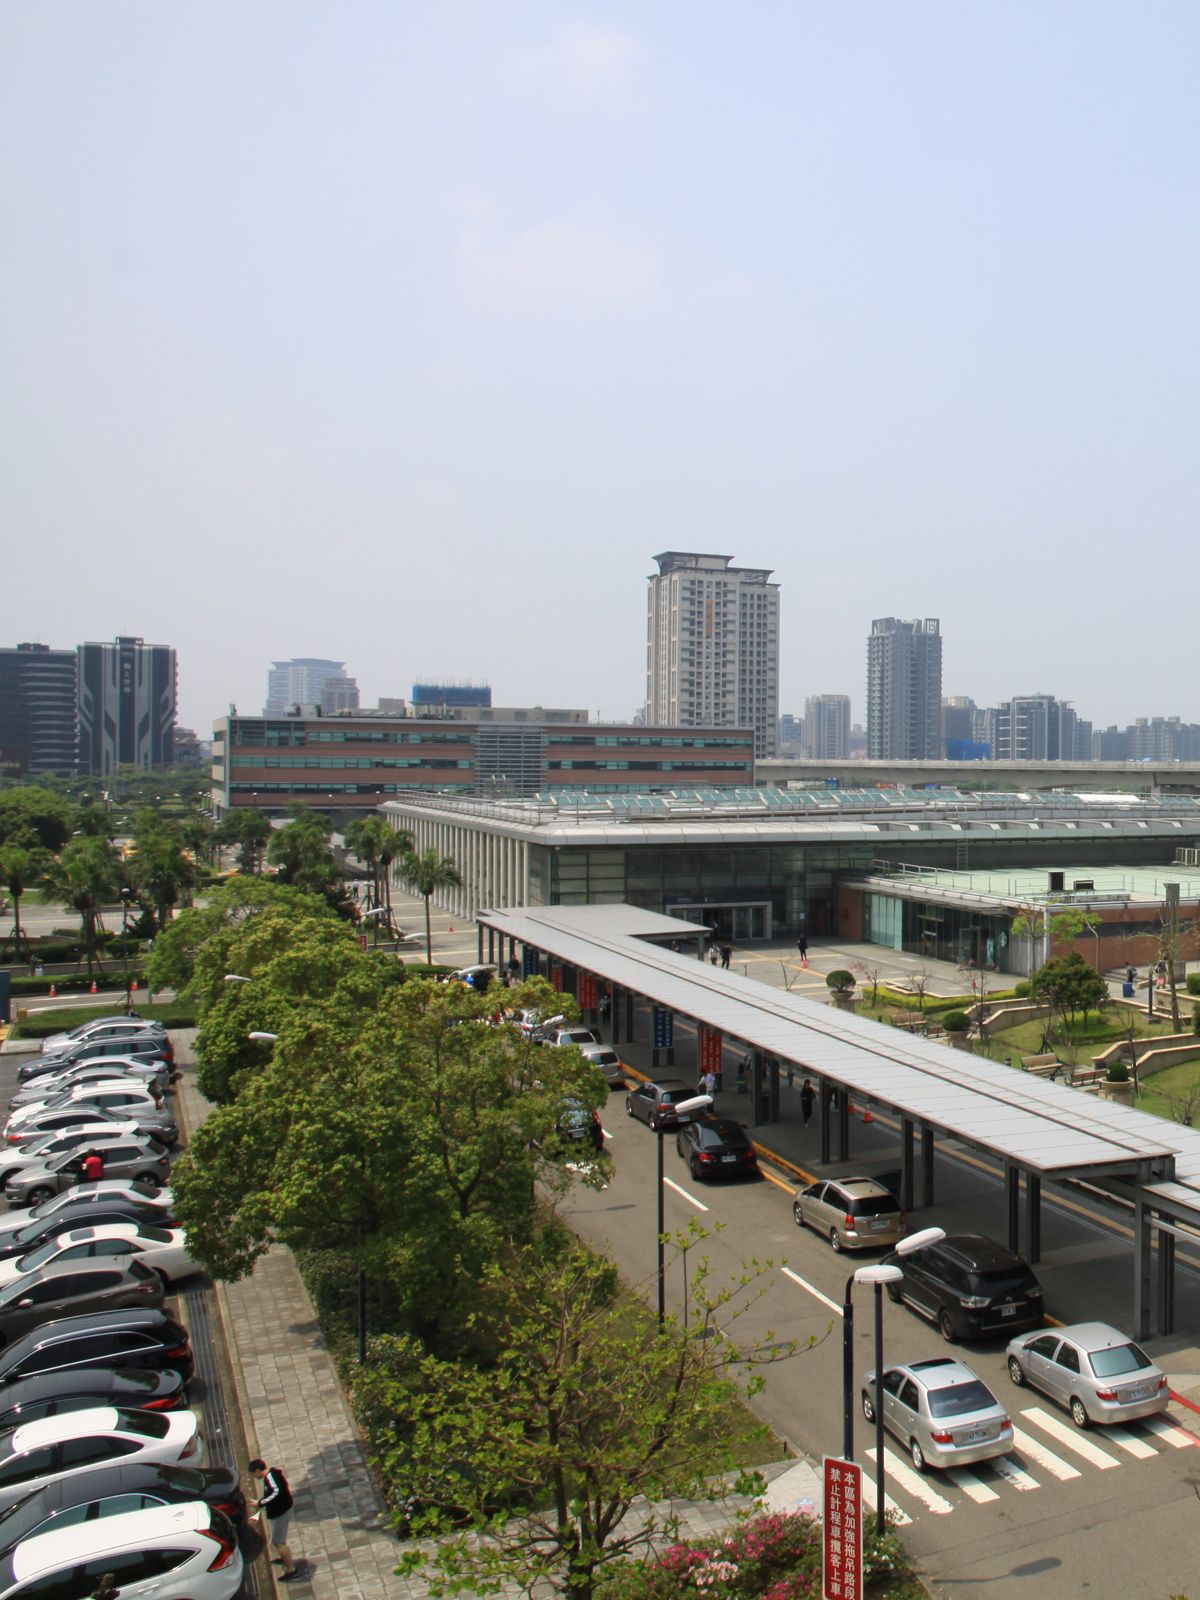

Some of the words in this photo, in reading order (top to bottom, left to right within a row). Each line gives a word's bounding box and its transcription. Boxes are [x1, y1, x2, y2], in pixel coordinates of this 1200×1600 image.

[830, 1467, 841, 1596] 禁止計程車攬客上車
[844, 1471, 856, 1600] 本區為加強拖吊路段
